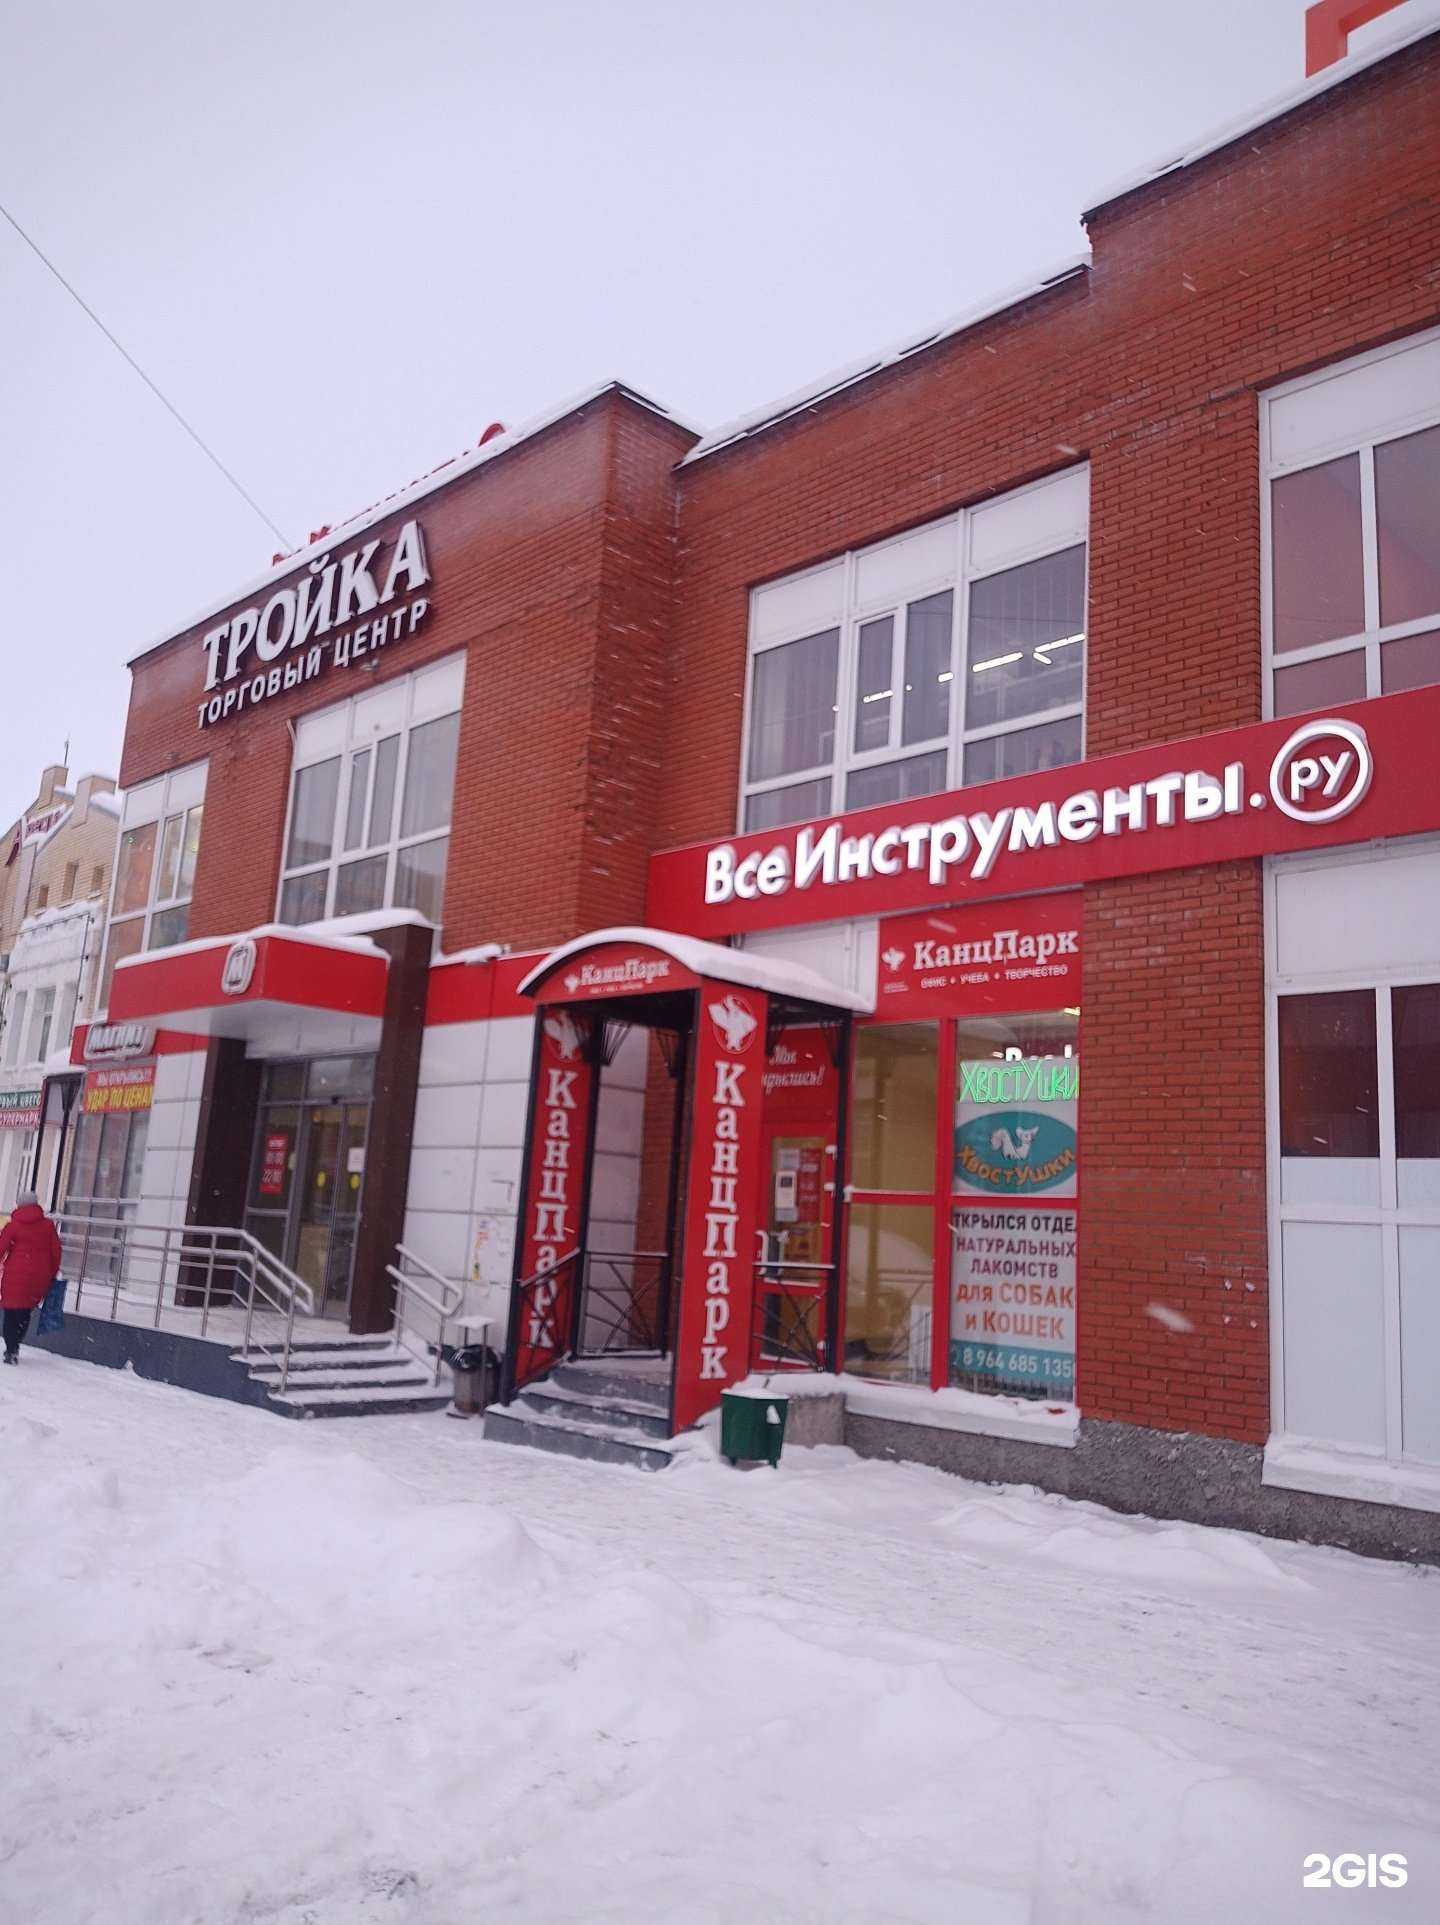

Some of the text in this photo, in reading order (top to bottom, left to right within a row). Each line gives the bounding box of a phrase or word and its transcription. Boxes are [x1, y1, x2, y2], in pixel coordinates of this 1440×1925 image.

[203, 519, 431, 692] ТРОЙКА
[198, 598, 431, 728] ТОРГОВЫЙ ЦЕНТР
[913, 930, 1080, 970] КанцПарк
[1005, 964, 1069, 981] ТВОРЧЕСТВО
[527, 1068, 578, 1349] КанцПарк
[700, 1060, 745, 1379] КанцПарк
[1031, 1216, 1077, 1234] ОТДЕ
[956, 1237, 1076, 1257] НАТУРАЛЬНЫХ
[970, 1259, 1058, 1278] ЛАКОМСТВ
[957, 1283, 1074, 1309] для СОБАК
[983, 1310, 1065, 1339] КОШЕК
[963, 1347, 973, 1366] 8
[977, 1350, 1004, 1369] 964
[1009, 1353, 1037, 1373] 685
